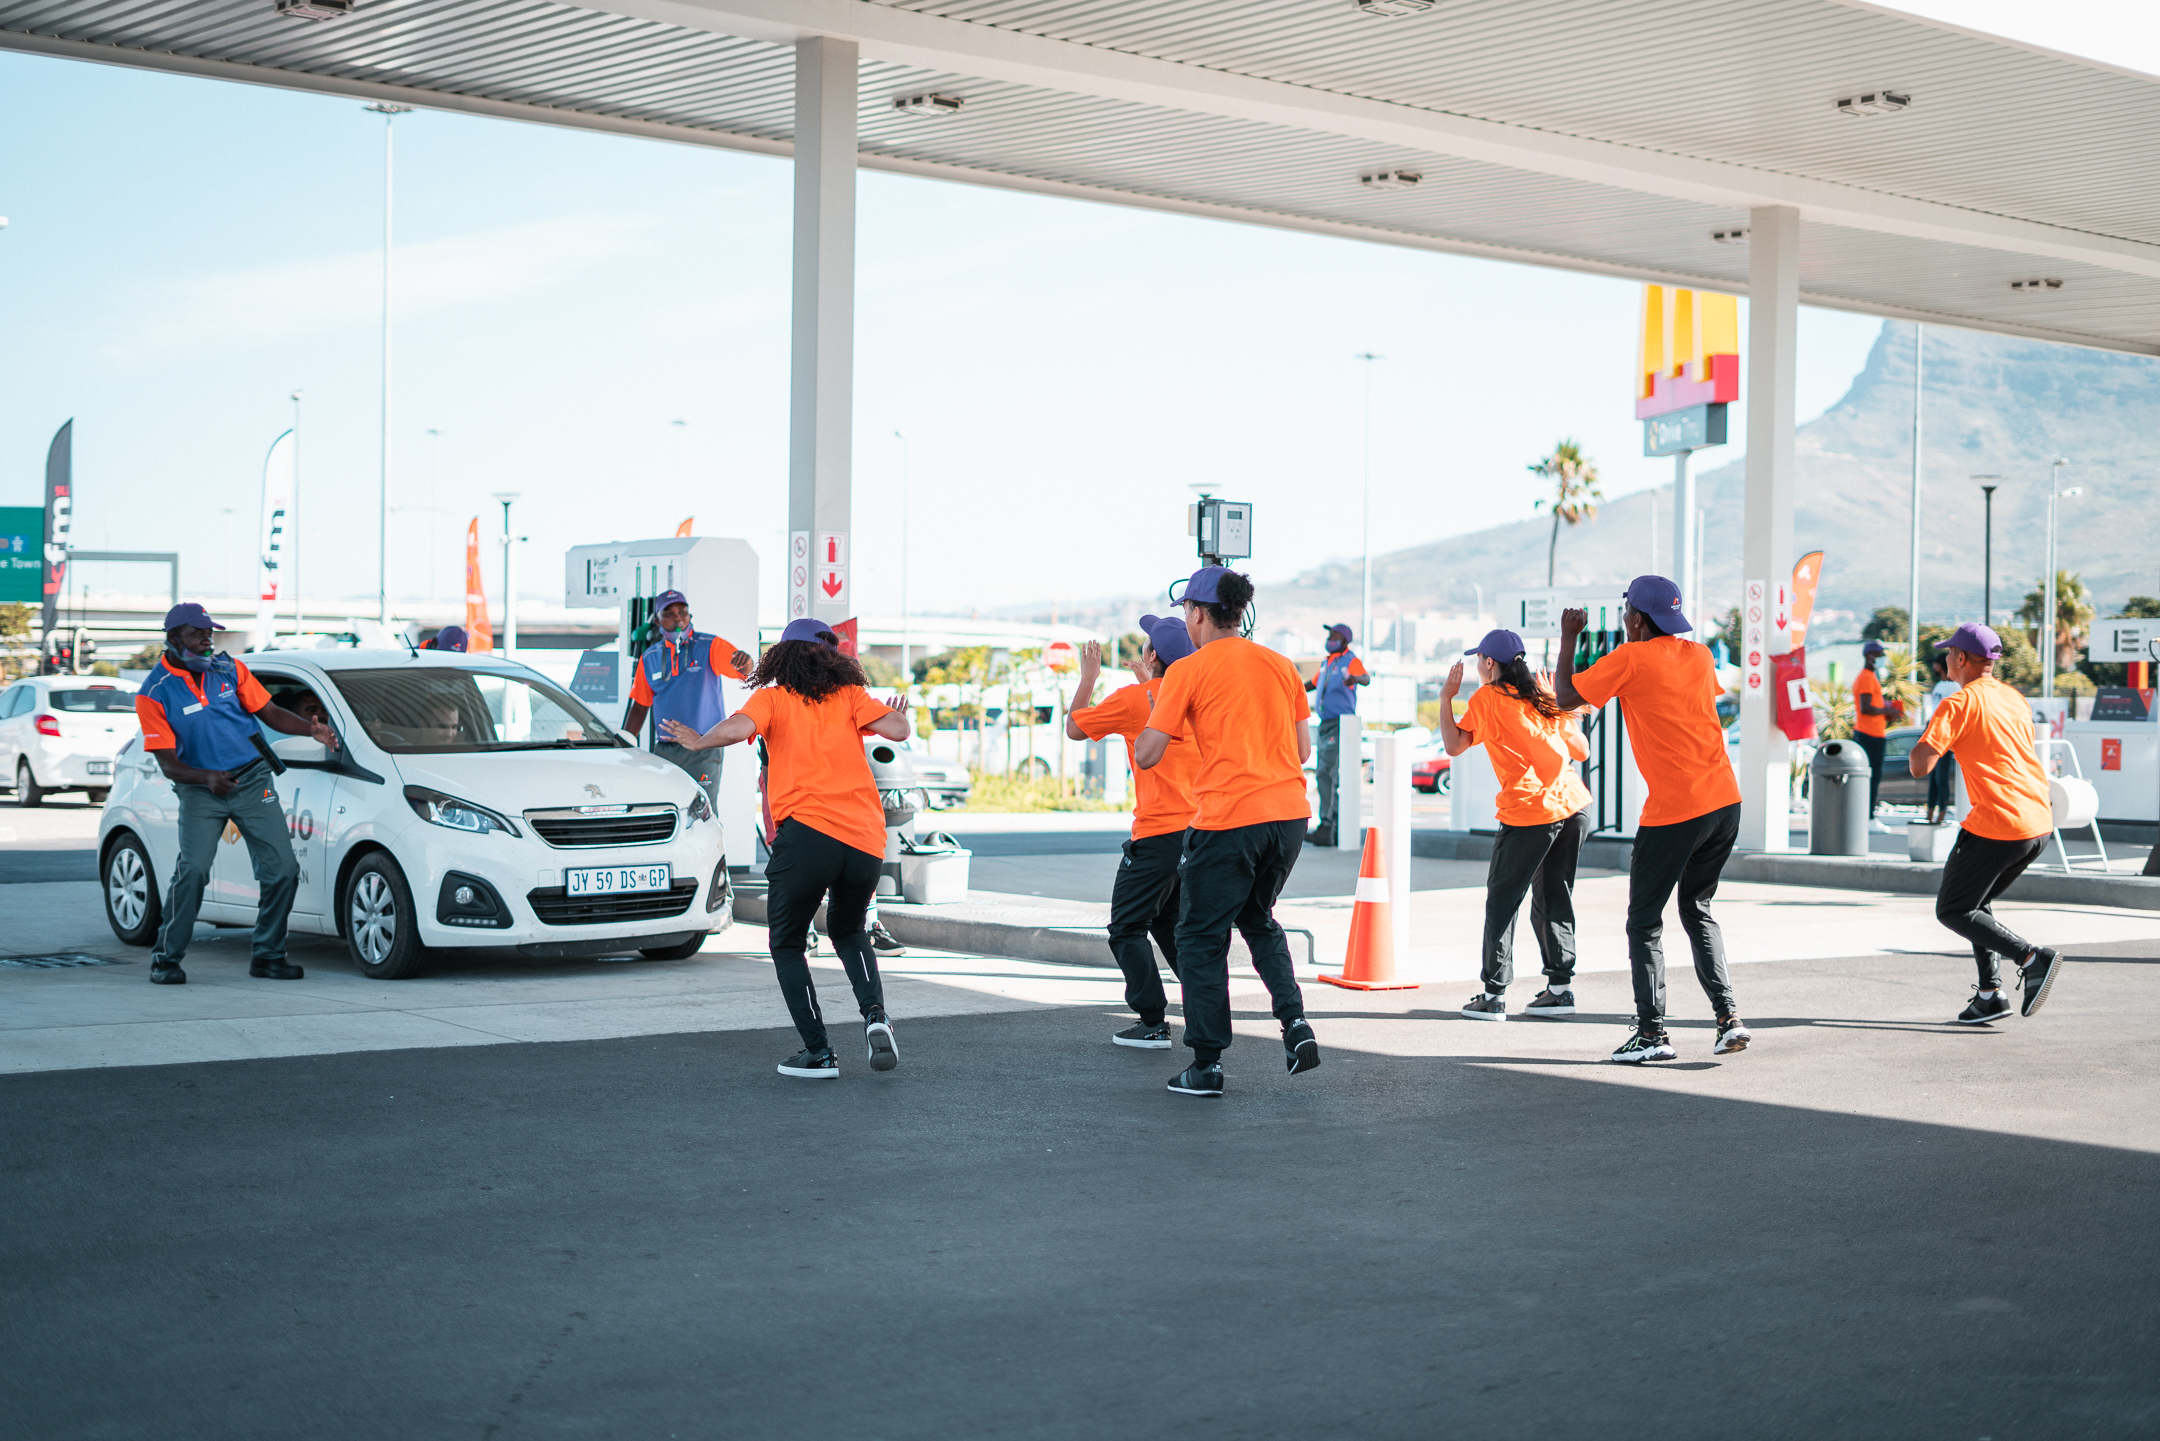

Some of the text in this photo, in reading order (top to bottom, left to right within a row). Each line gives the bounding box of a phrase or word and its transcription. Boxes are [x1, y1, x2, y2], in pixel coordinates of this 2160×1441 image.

[1659, 421, 1682, 445] Drive
[43, 496, 71, 595] kfm
[261, 510, 285, 601] kfm
[11, 557, 42, 569] Town
[572, 869, 666, 892] JY 59 DS GP
